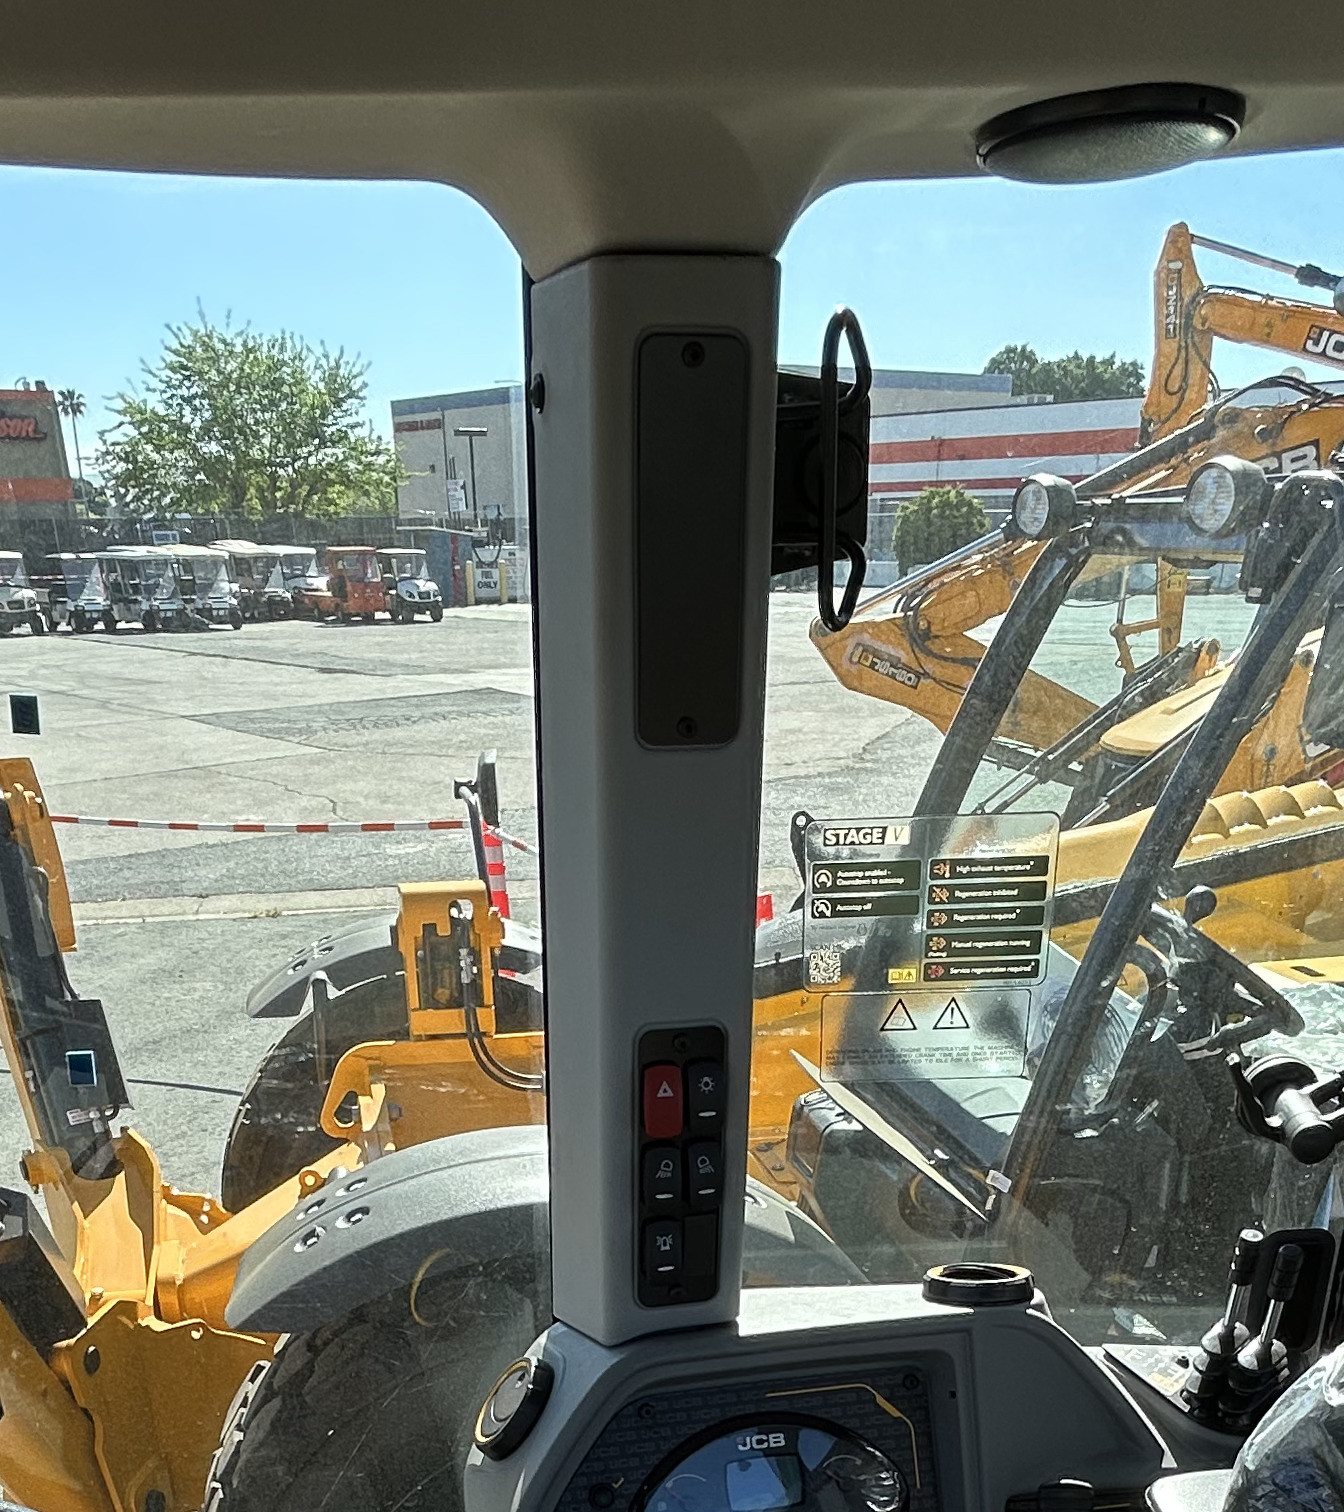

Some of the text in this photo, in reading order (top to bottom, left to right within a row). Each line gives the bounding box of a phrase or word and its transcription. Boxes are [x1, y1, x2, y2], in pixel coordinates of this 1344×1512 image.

[477, 581, 498, 589] ONLY
[824, 826, 905, 846] STAGE V
[737, 1433, 786, 1451] JCB
